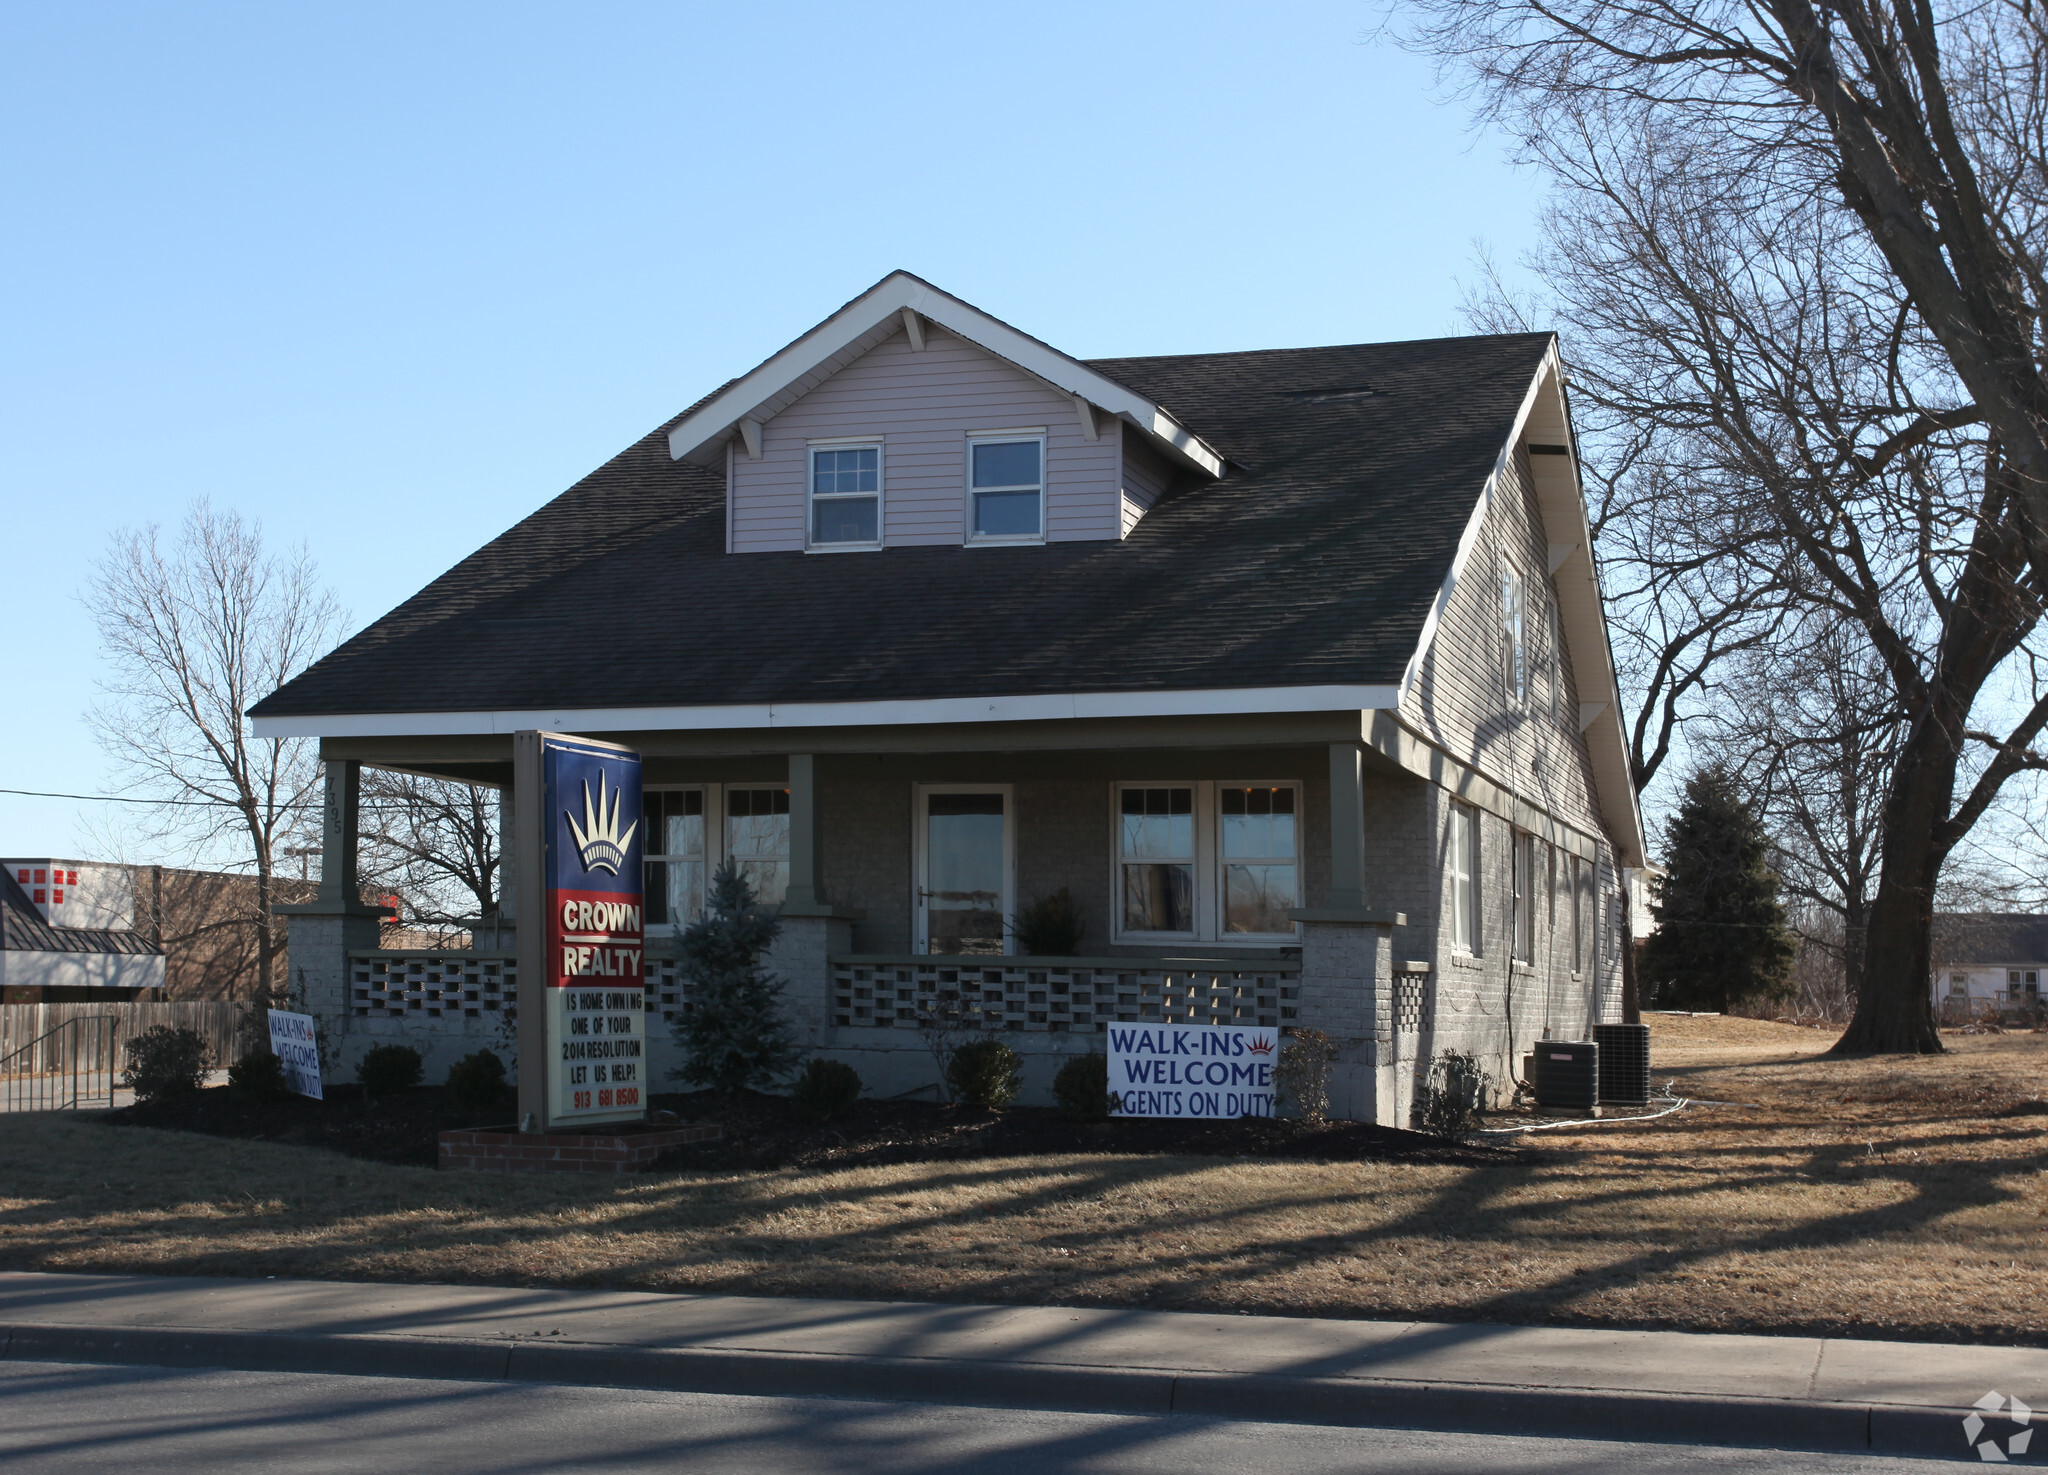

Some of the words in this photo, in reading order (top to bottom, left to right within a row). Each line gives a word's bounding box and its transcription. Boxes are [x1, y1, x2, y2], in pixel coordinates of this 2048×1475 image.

[327, 777, 342, 834] 7395
[564, 900, 640, 932] CROWN
[563, 946, 641, 976] REALTY
[566, 993, 577, 1010] IS
[580, 993, 603, 1010] HOME
[606, 992, 642, 1010] OWNING
[269, 1016, 306, 1042] WALK-INS
[571, 1017, 588, 1034] ONE
[593, 1017, 604, 1034] OF
[607, 1016, 631, 1033] YOUR
[276, 1041, 317, 1070] WELCOME
[562, 1042, 585, 1060] 2014
[587, 1040, 641, 1059] RESOLUTION
[1110, 1028, 1244, 1057] WALK-INS
[571, 1066, 587, 1084] LET
[595, 1065, 607, 1082] US
[612, 1064, 636, 1081] HELP!
[1124, 1059, 1271, 1087] WELCOME
[574, 1090, 591, 1109] 913
[598, 1089, 613, 1106] 681
[616, 1087, 639, 1105] 8500
[1108, 1090, 1182, 1116] AGENTS
[1189, 1092, 1219, 1116] ON
[1226, 1093, 1275, 1117] DUTY
